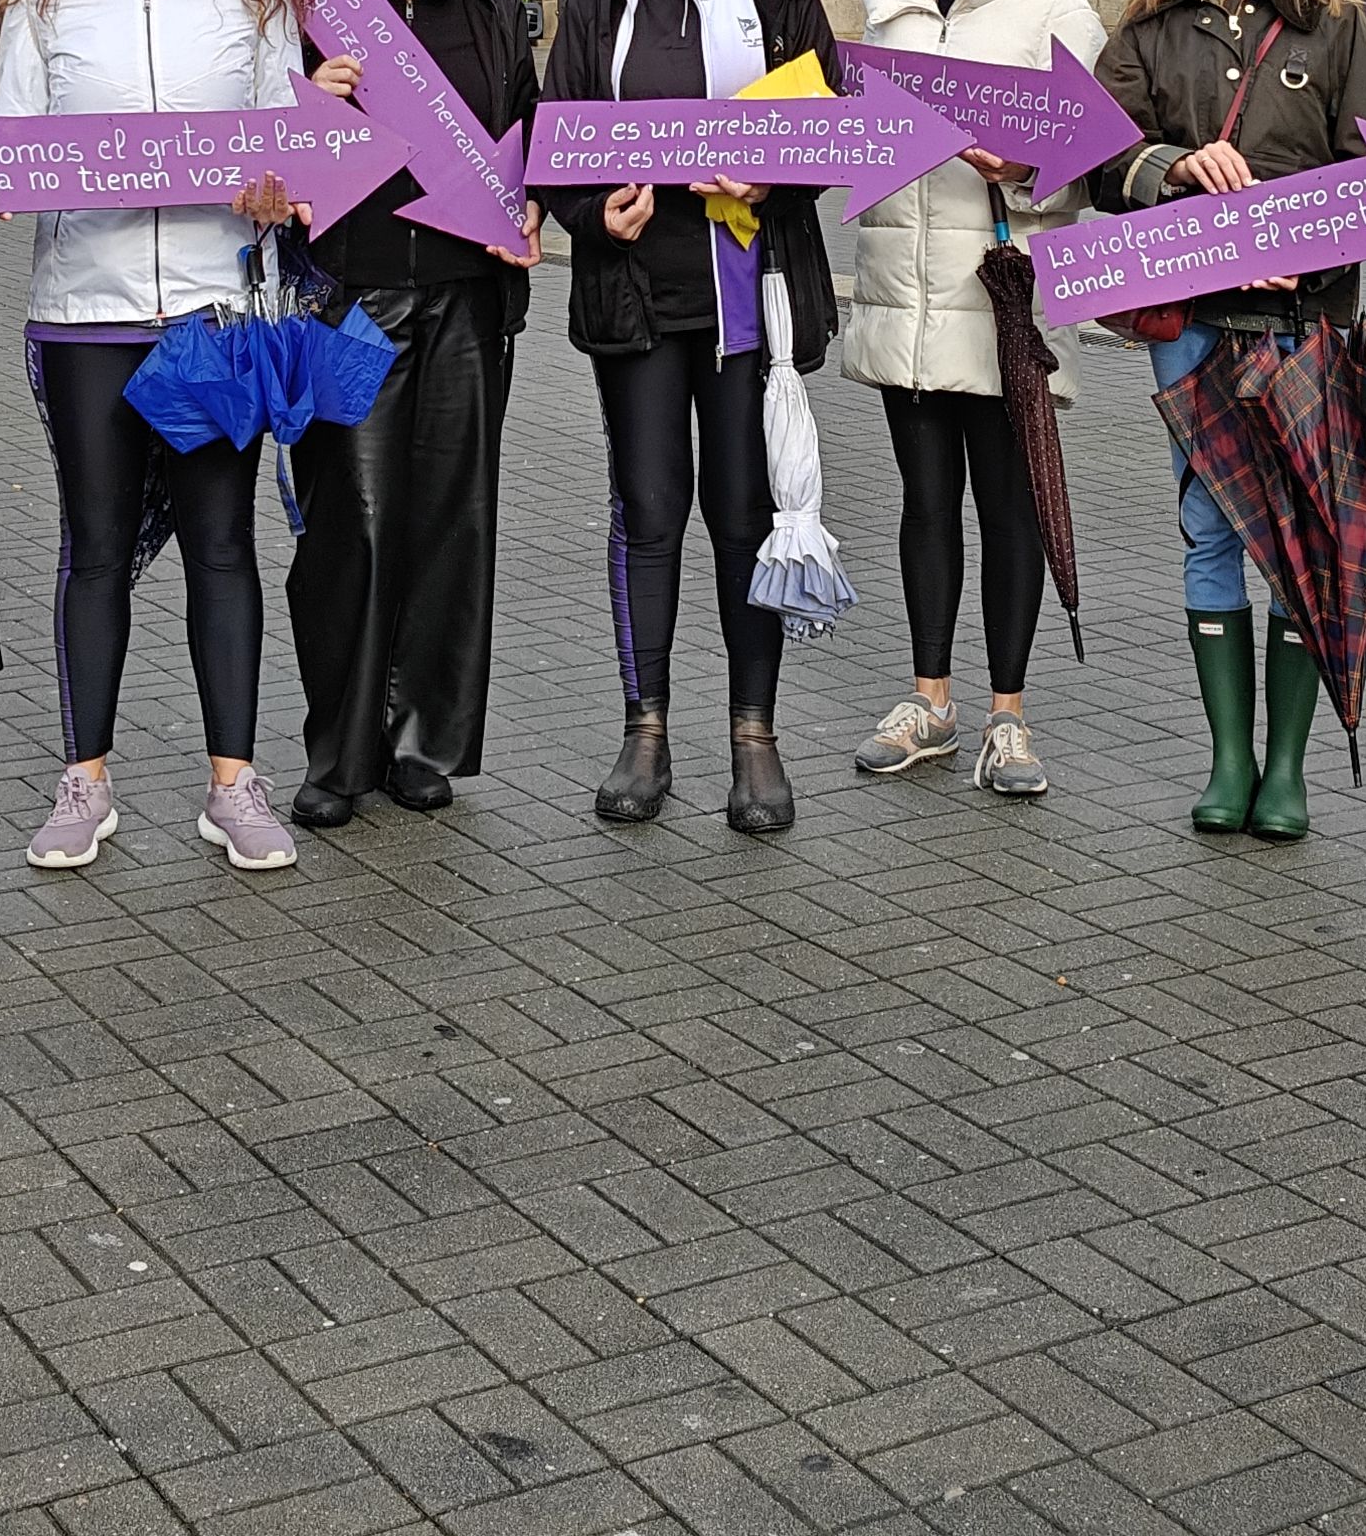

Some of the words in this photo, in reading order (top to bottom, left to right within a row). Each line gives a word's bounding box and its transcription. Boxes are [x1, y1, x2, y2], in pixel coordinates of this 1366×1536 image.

[844, 51, 923, 92] hobre
[931, 65, 958, 98] de
[1058, 98, 1084, 119] no
[367, 15, 393, 45] no
[393, 50, 430, 93] son
[428, 91, 528, 229] herramientas
[554, 114, 596, 143] No
[611, 121, 641, 141] es
[649, 119, 684, 139] un
[838, 117, 865, 135] es
[876, 117, 914, 134] un
[954, 105, 990, 127] una
[98, 128, 126, 162] el
[141, 120, 216, 169] grito
[228, 119, 265, 154] de
[274, 119, 317, 152] las
[325, 126, 373, 160] que
[661, 141, 765, 167] violencia
[779, 139, 896, 166] machista
[29, 170, 61, 191] no
[79, 165, 171, 193] tienen
[1047, 245, 1077, 270] La
[1082, 216, 1203, 257] violencia
[1213, 201, 1240, 230] de
[1247, 187, 1328, 230] género
[1053, 261, 1126, 301] donde
[1139, 241, 1240, 281] termina
[1254, 220, 1282, 253] el
